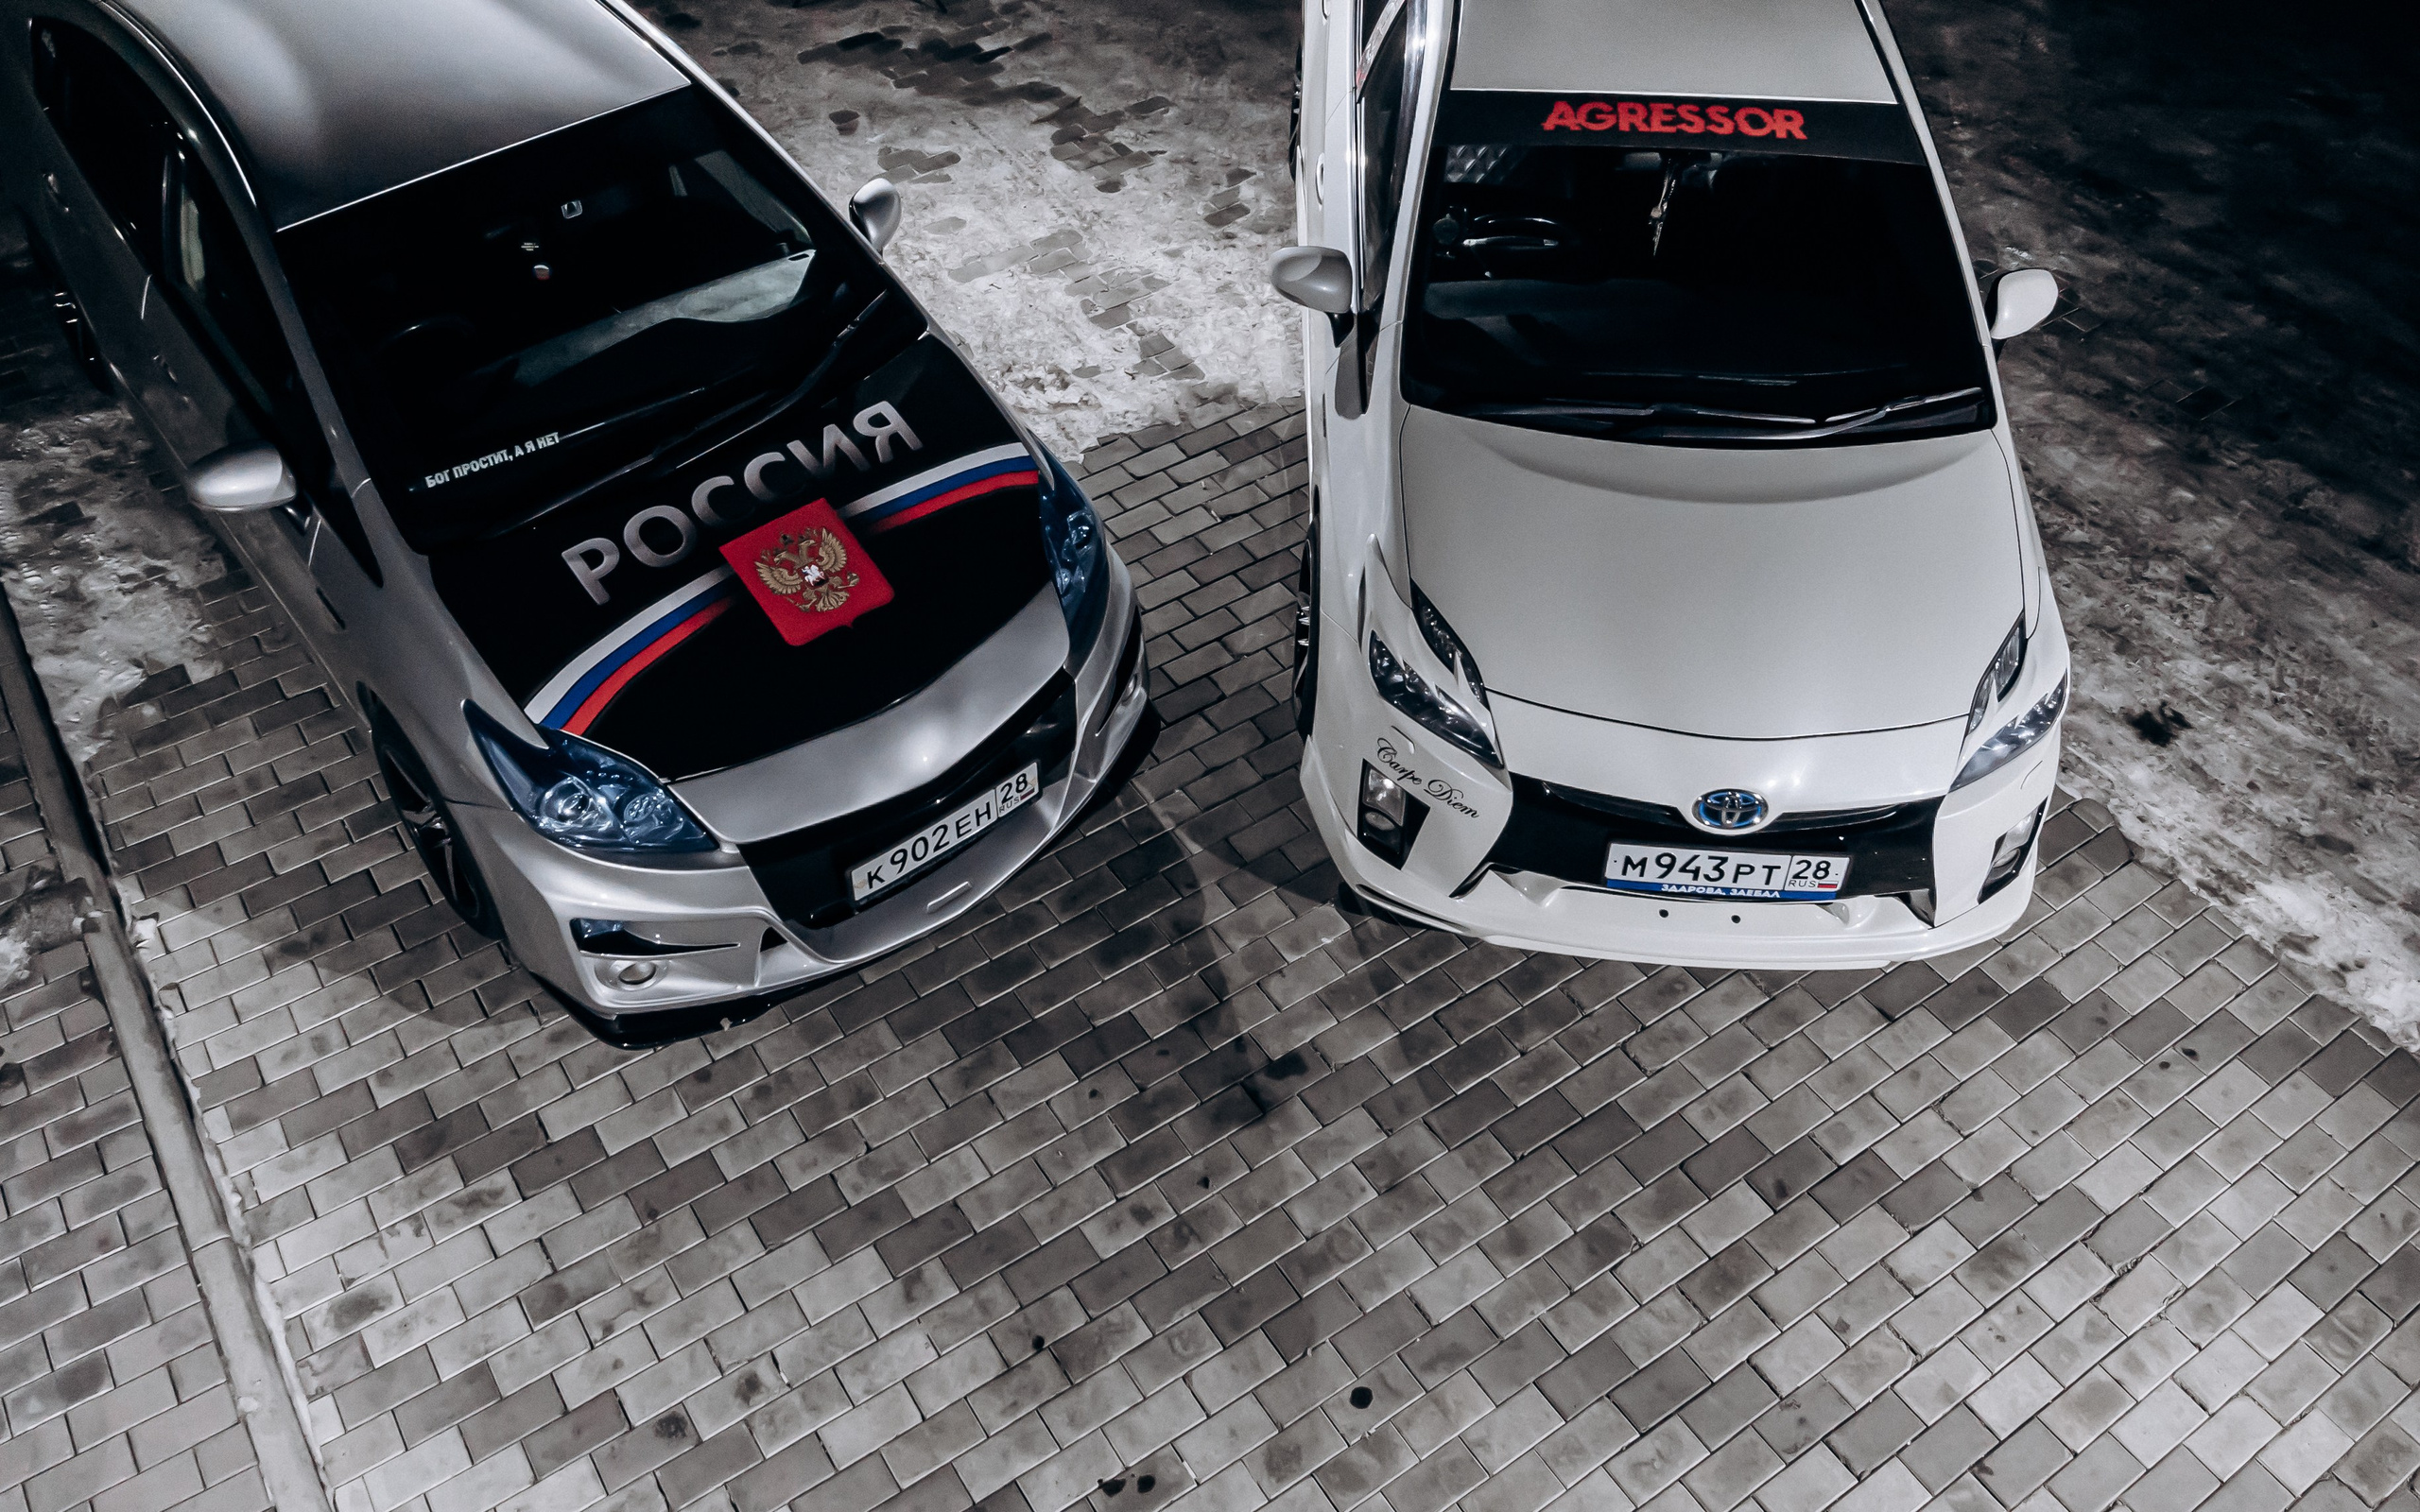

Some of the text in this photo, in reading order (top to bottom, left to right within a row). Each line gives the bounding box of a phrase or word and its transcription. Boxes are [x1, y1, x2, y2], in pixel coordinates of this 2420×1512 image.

[1541, 100, 1807, 140] AGRESSOR
[424, 432, 560, 488] БОГ ПРОСТИТ, А Я НЕТ
[561, 400, 924, 606] РОССИЯ
[999, 773, 1028, 805] 28
[1376, 737, 1480, 818] Carpe Diem
[998, 796, 1021, 814] RUS
[1788, 880, 1817, 888] RUS
[1791, 859, 1832, 880] 28
[1729, 888, 1781, 899] ЗАЕБАЛ
